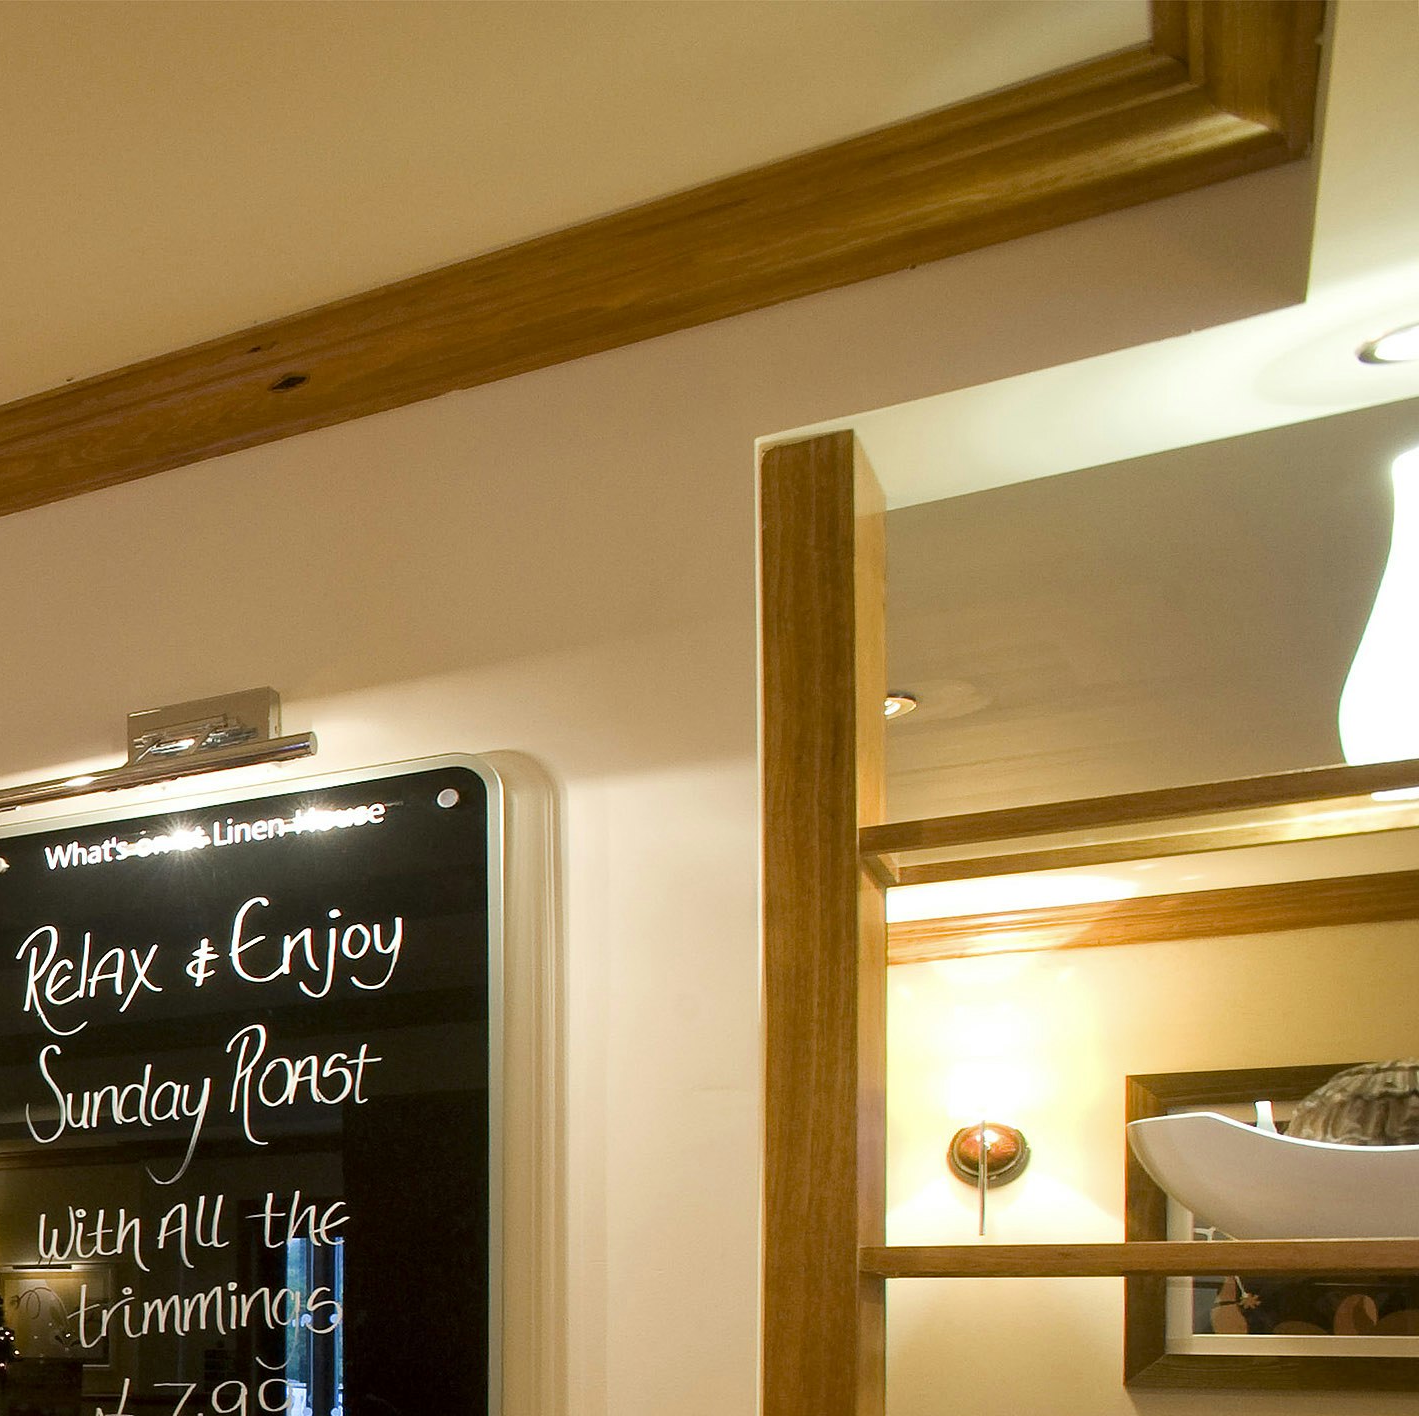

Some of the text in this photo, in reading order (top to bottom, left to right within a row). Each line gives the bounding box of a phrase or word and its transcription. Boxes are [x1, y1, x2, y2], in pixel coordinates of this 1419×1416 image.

[44, 836, 129, 870] What's
[213, 816, 284, 847] Linen
[229, 896, 404, 998] Enjoy
[26, 1044, 212, 1185] Sunday
[157, 1194, 230, 1269] All
[245, 1190, 351, 1249] the
[66, 1282, 344, 1370] trimmings
